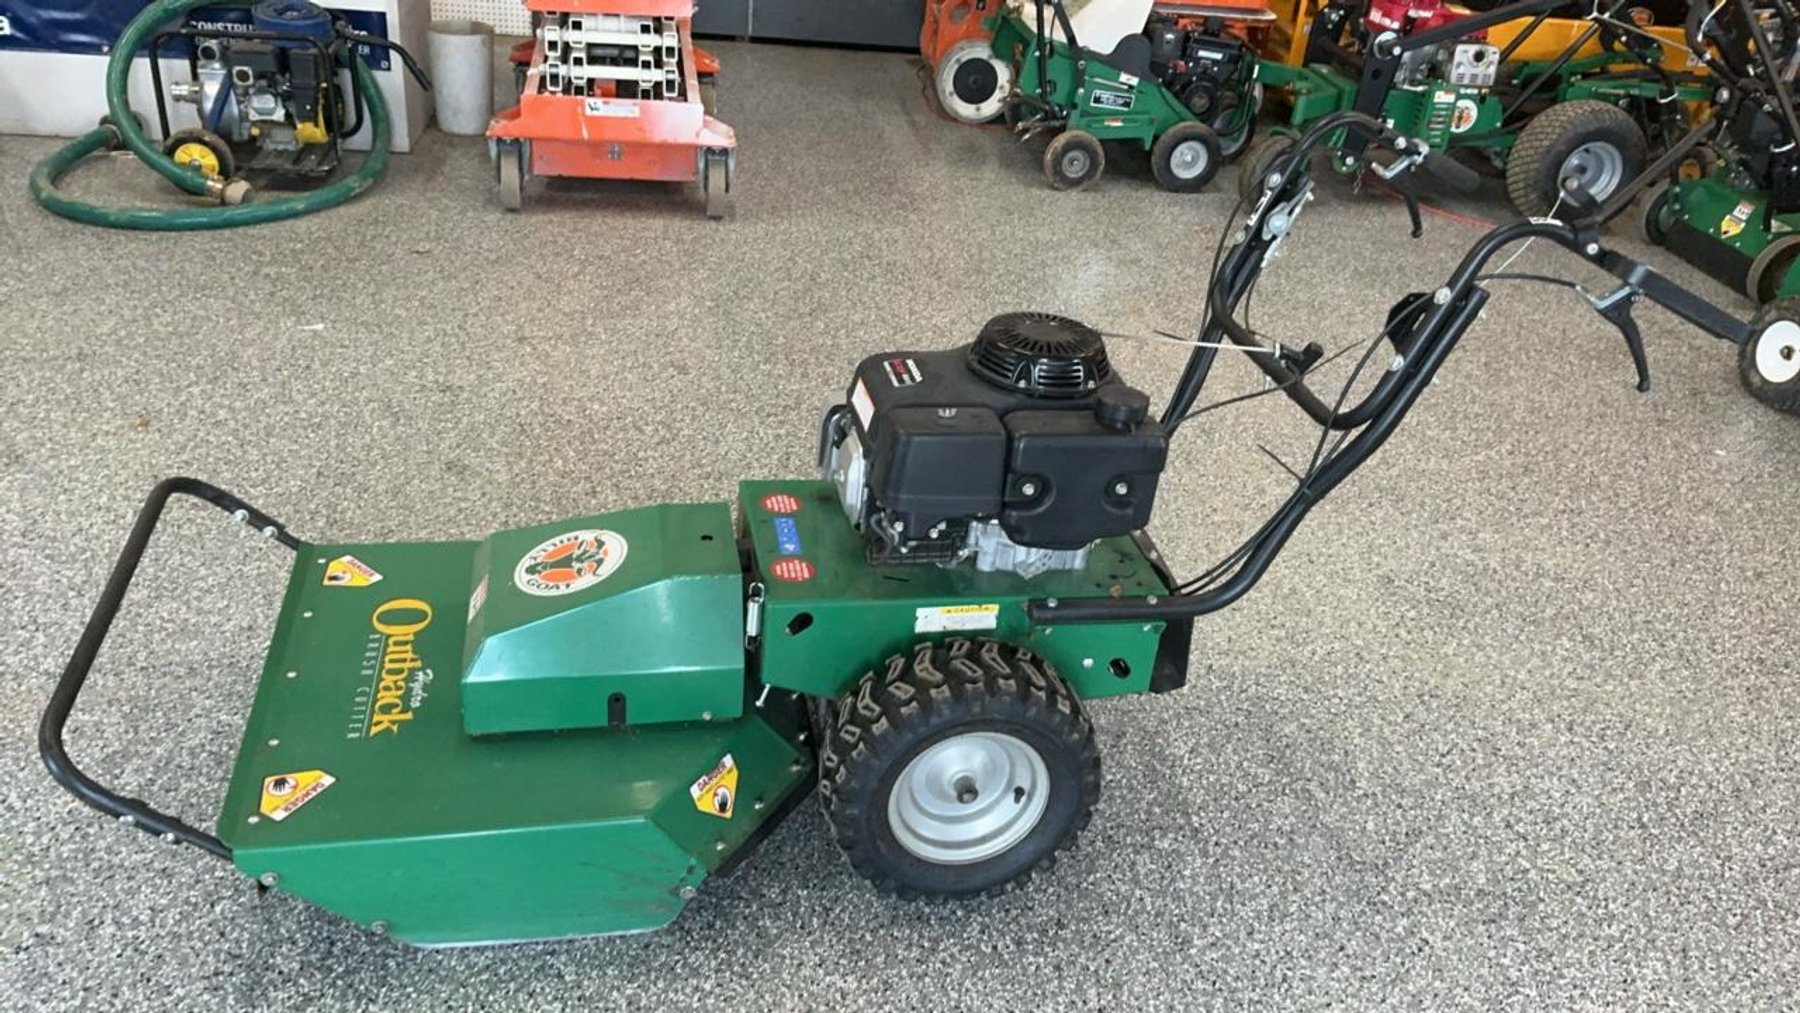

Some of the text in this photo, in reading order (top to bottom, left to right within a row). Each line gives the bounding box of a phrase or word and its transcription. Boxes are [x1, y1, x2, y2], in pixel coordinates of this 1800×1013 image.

[526, 578, 572, 591] GOAT
[369, 598, 433, 737] Outback
[346, 633, 382, 739] BRUSH CUTTER
[408, 668, 434, 708] Hydro
[697, 761, 727, 792] DANGER
[281, 782, 325, 813] DANGER
